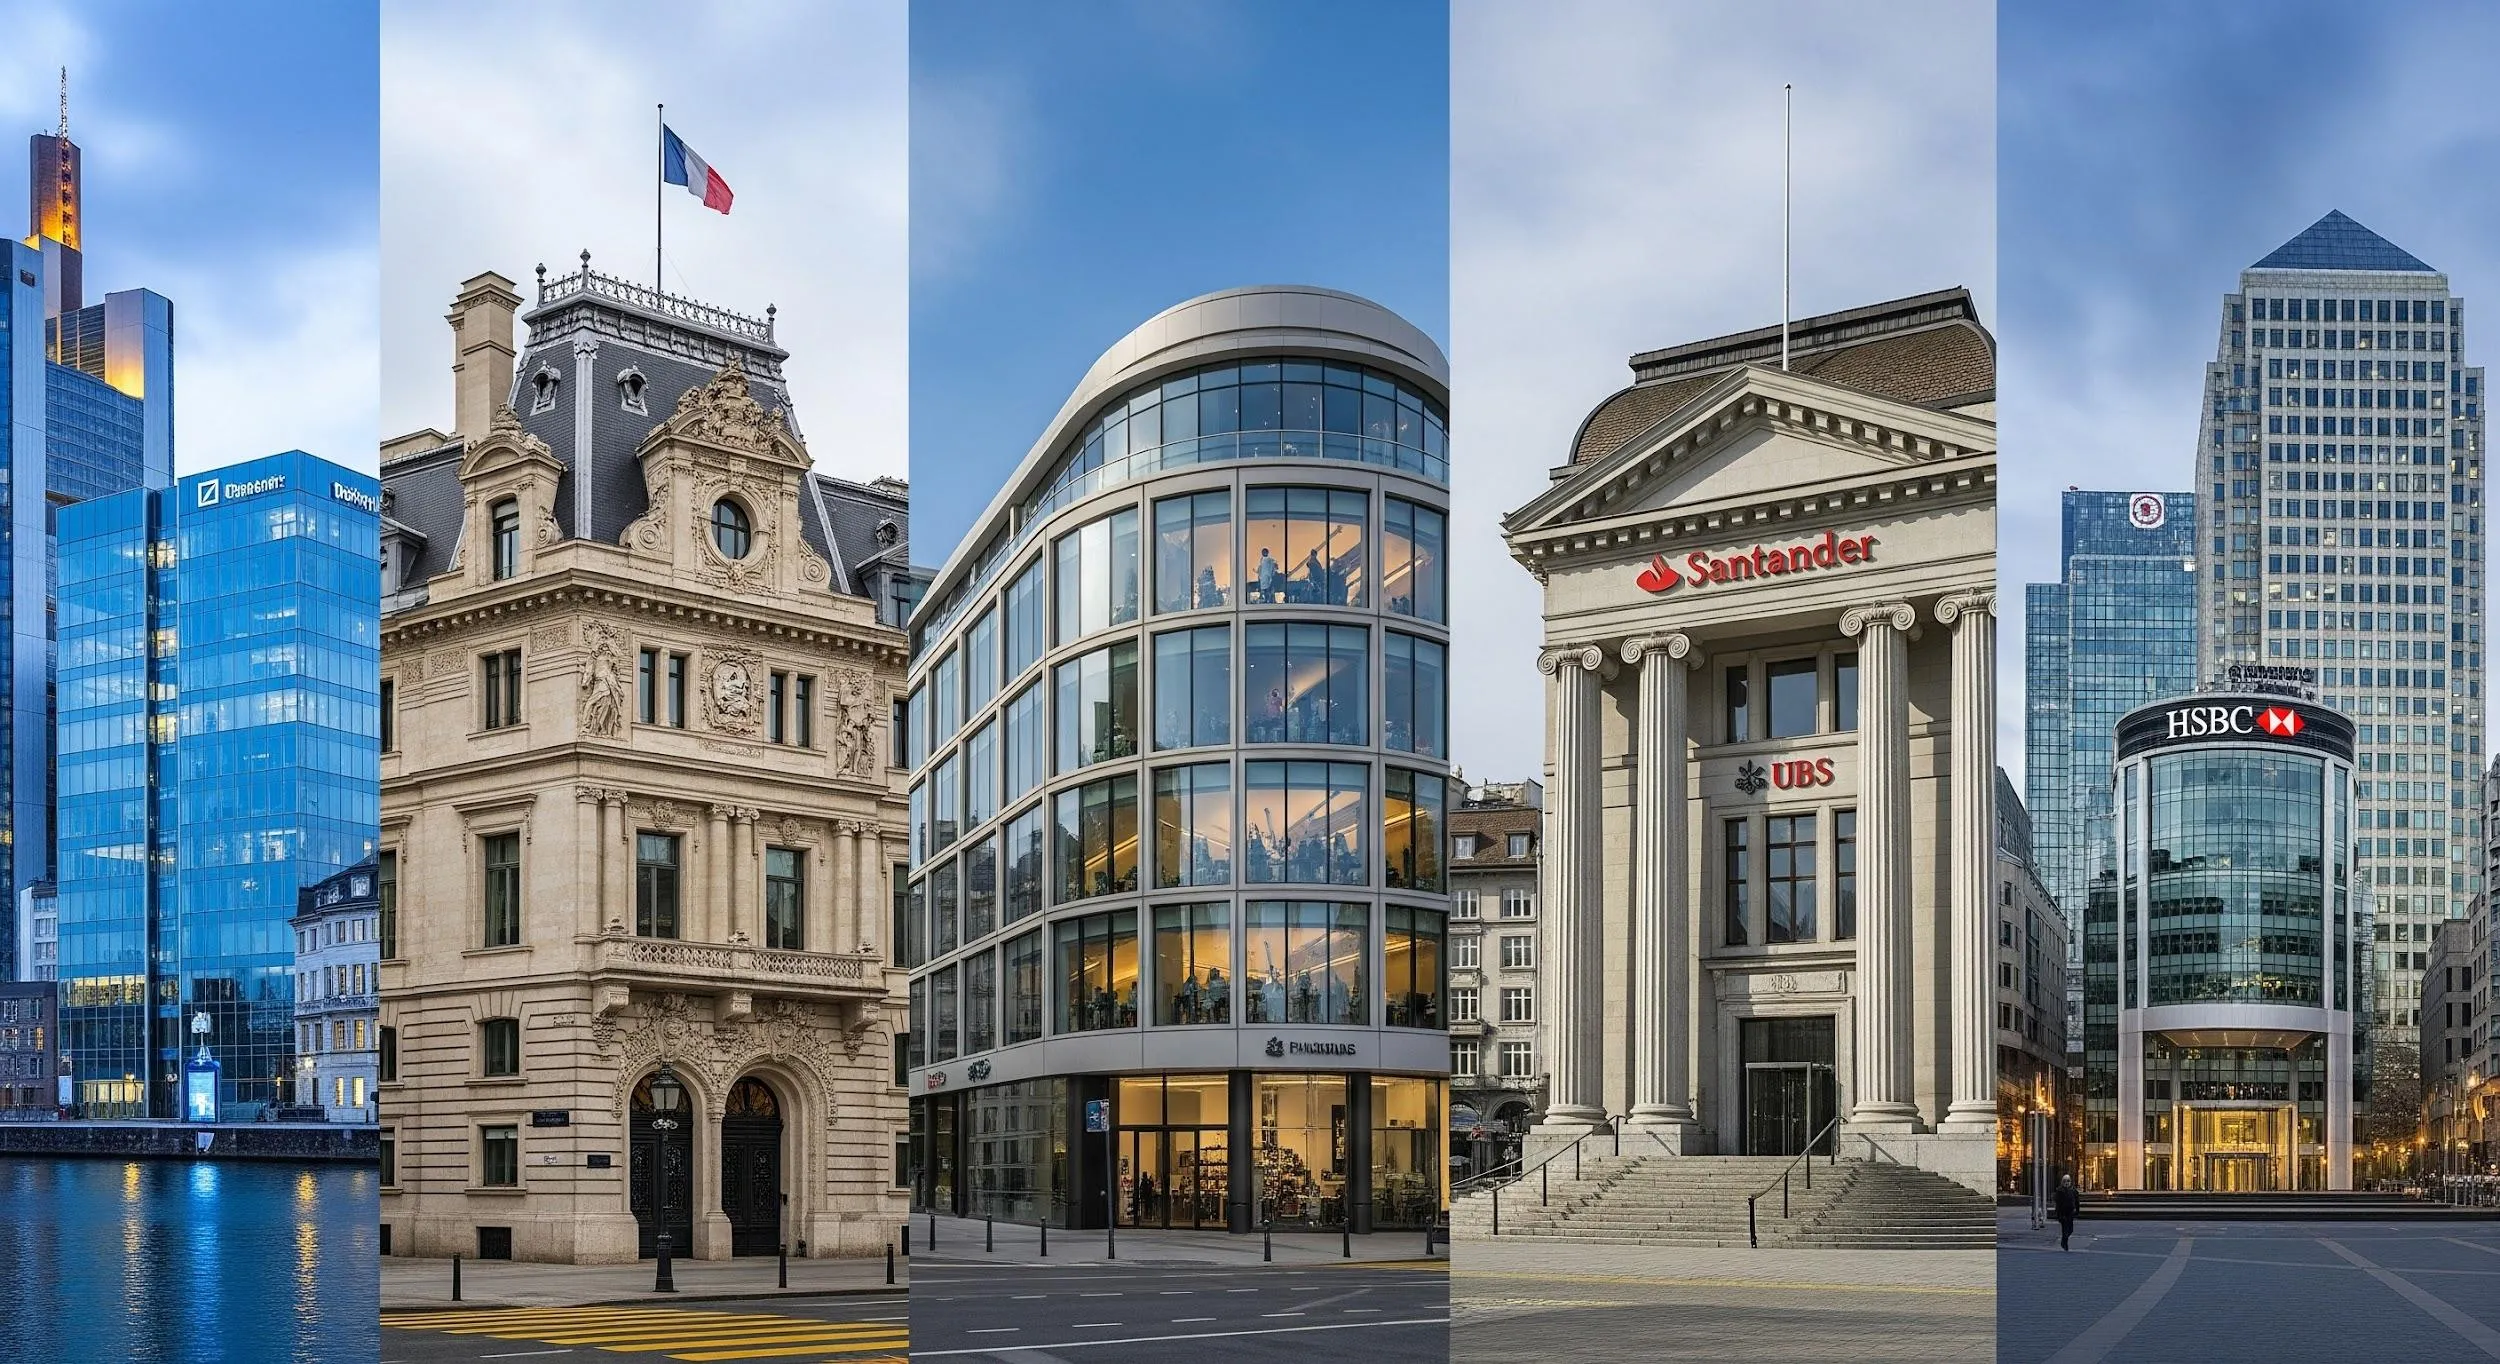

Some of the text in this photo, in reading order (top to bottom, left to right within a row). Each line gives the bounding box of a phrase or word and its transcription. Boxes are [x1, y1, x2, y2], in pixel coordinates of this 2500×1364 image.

[1687, 529, 1874, 587] Santander
[2166, 705, 2253, 740] HSBC
[1772, 757, 1835, 790] UBS
